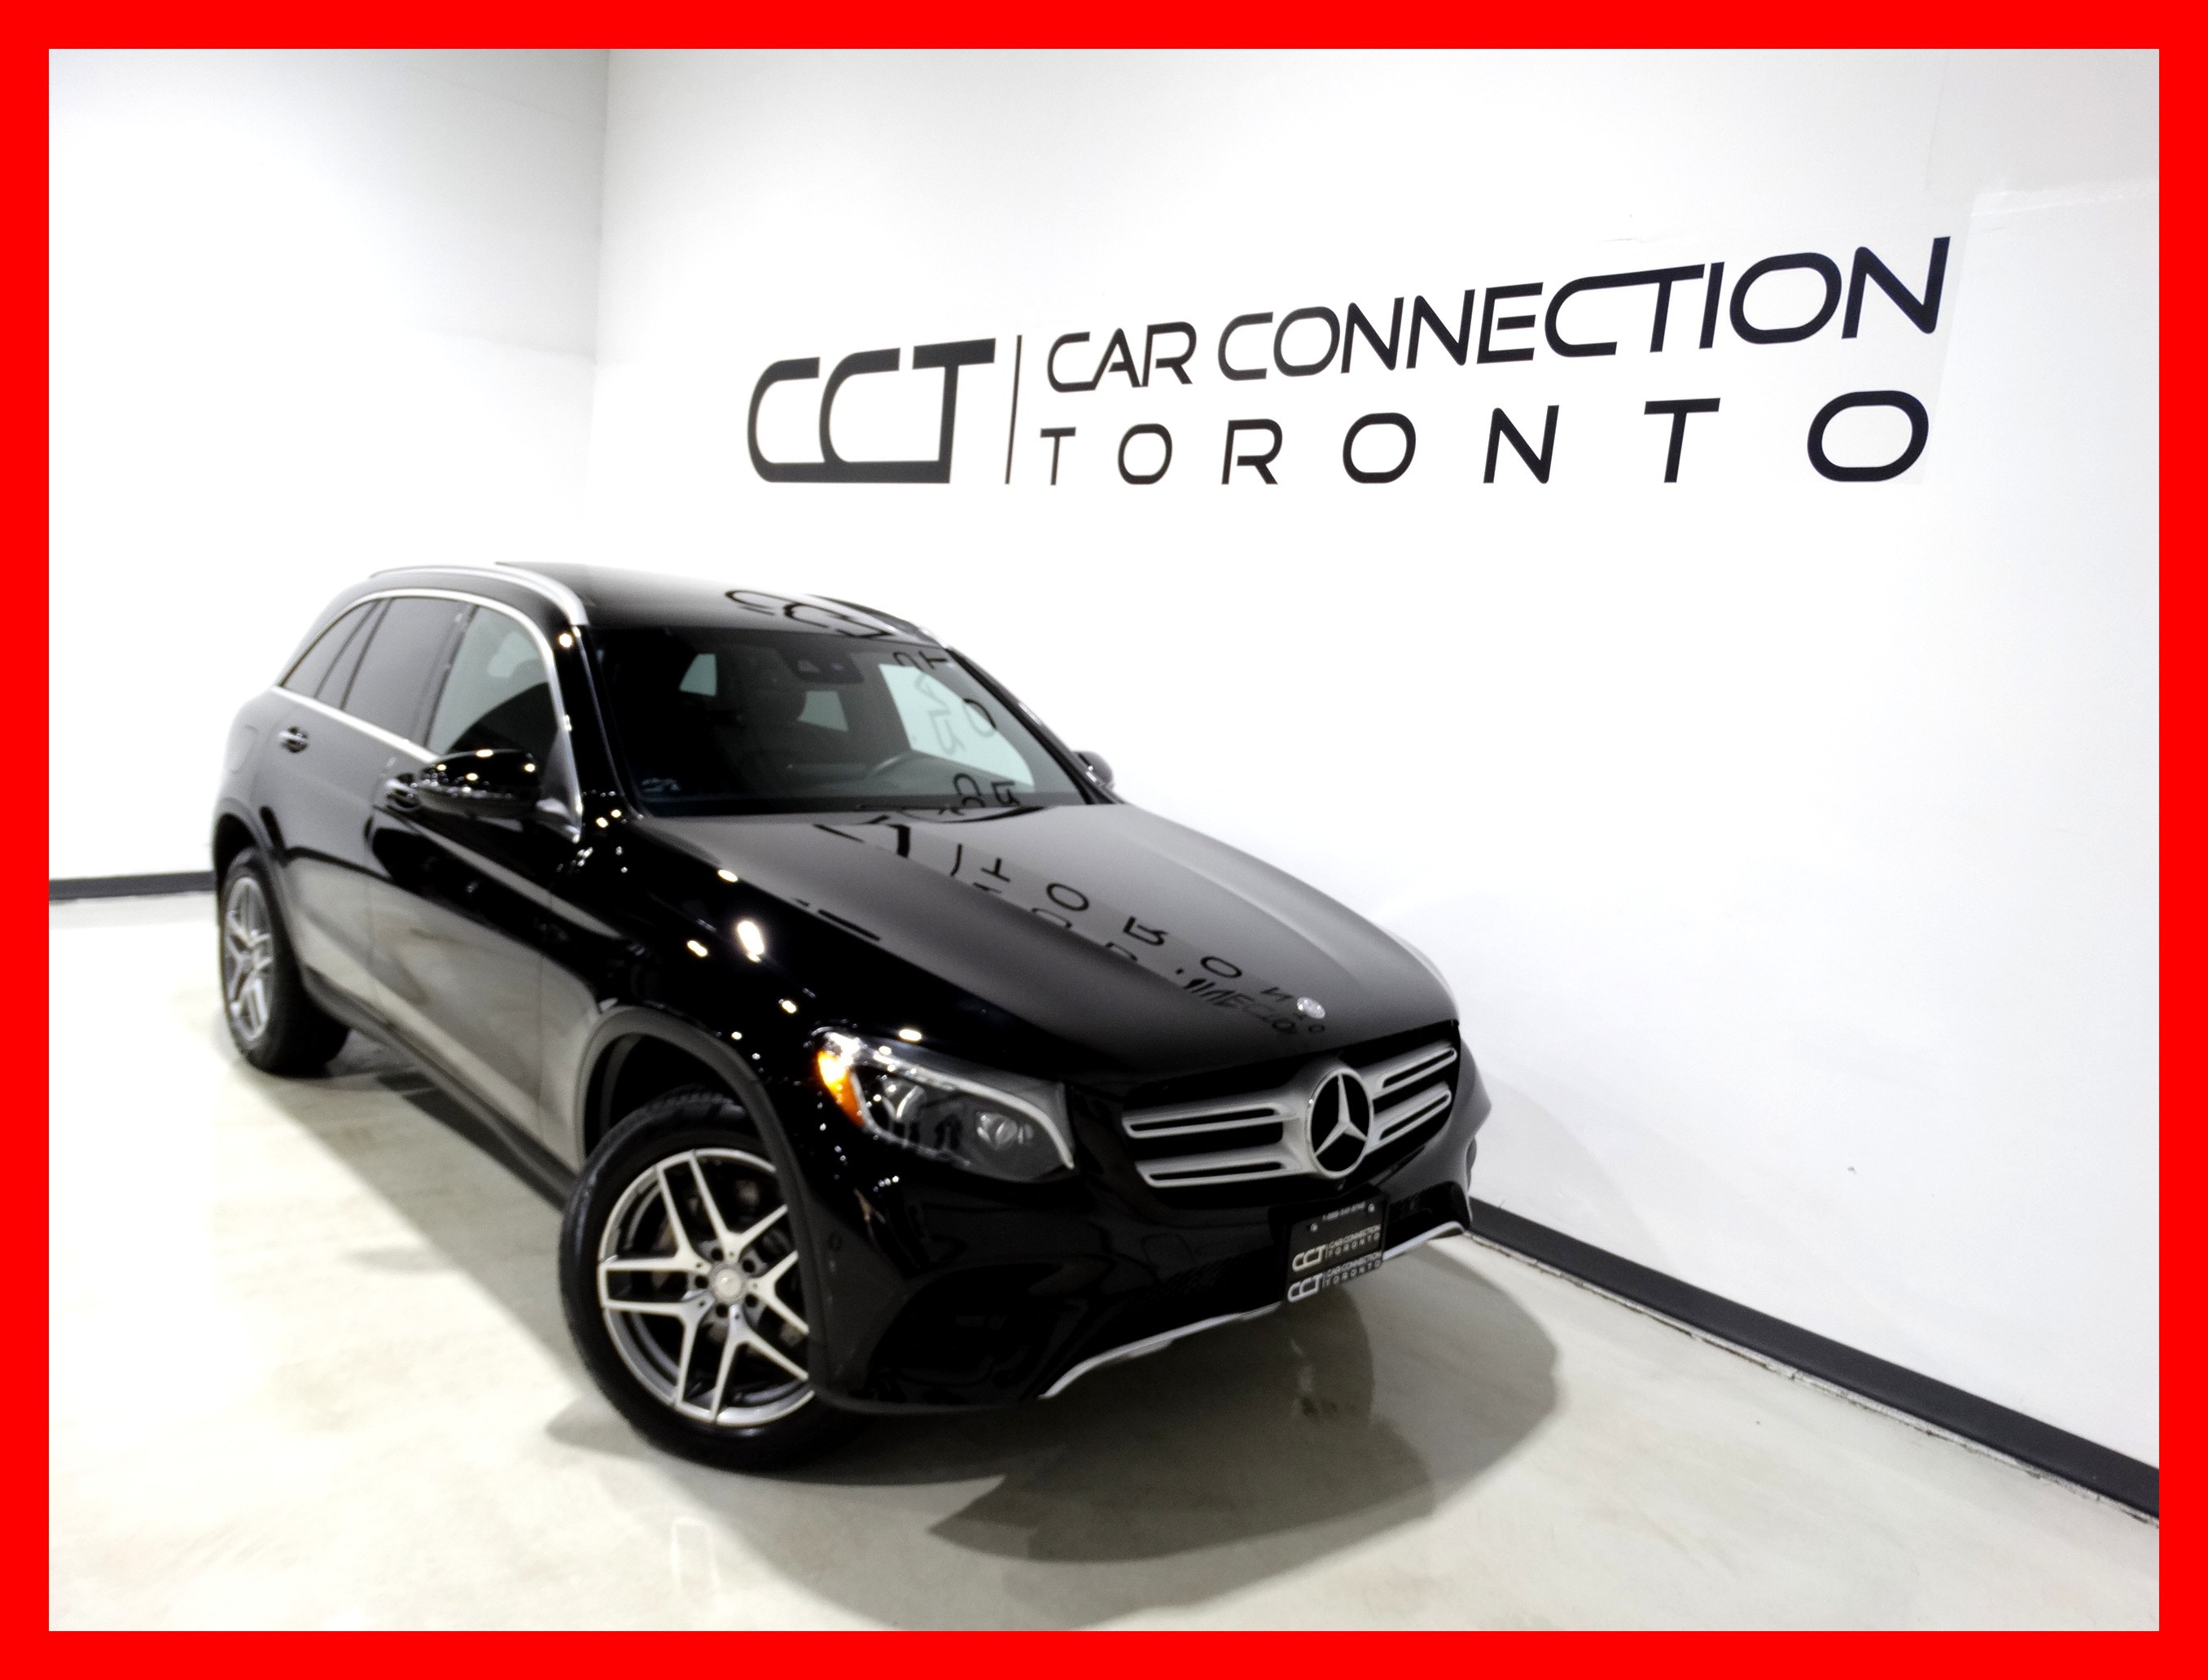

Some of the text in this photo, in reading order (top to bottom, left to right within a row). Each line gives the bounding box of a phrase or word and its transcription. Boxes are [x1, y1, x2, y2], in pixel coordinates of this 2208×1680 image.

[1047, 236, 1951, 393] CAR CONNECTION
[747, 338, 996, 483] CCT
[1040, 390, 1930, 485] TORONTO
[1291, 1244, 1326, 1272] CCT
[1328, 1232, 1381, 1258] TORONTO
[1287, 1271, 1324, 1302] CCT
[1325, 1258, 1382, 1286] TORONTO
